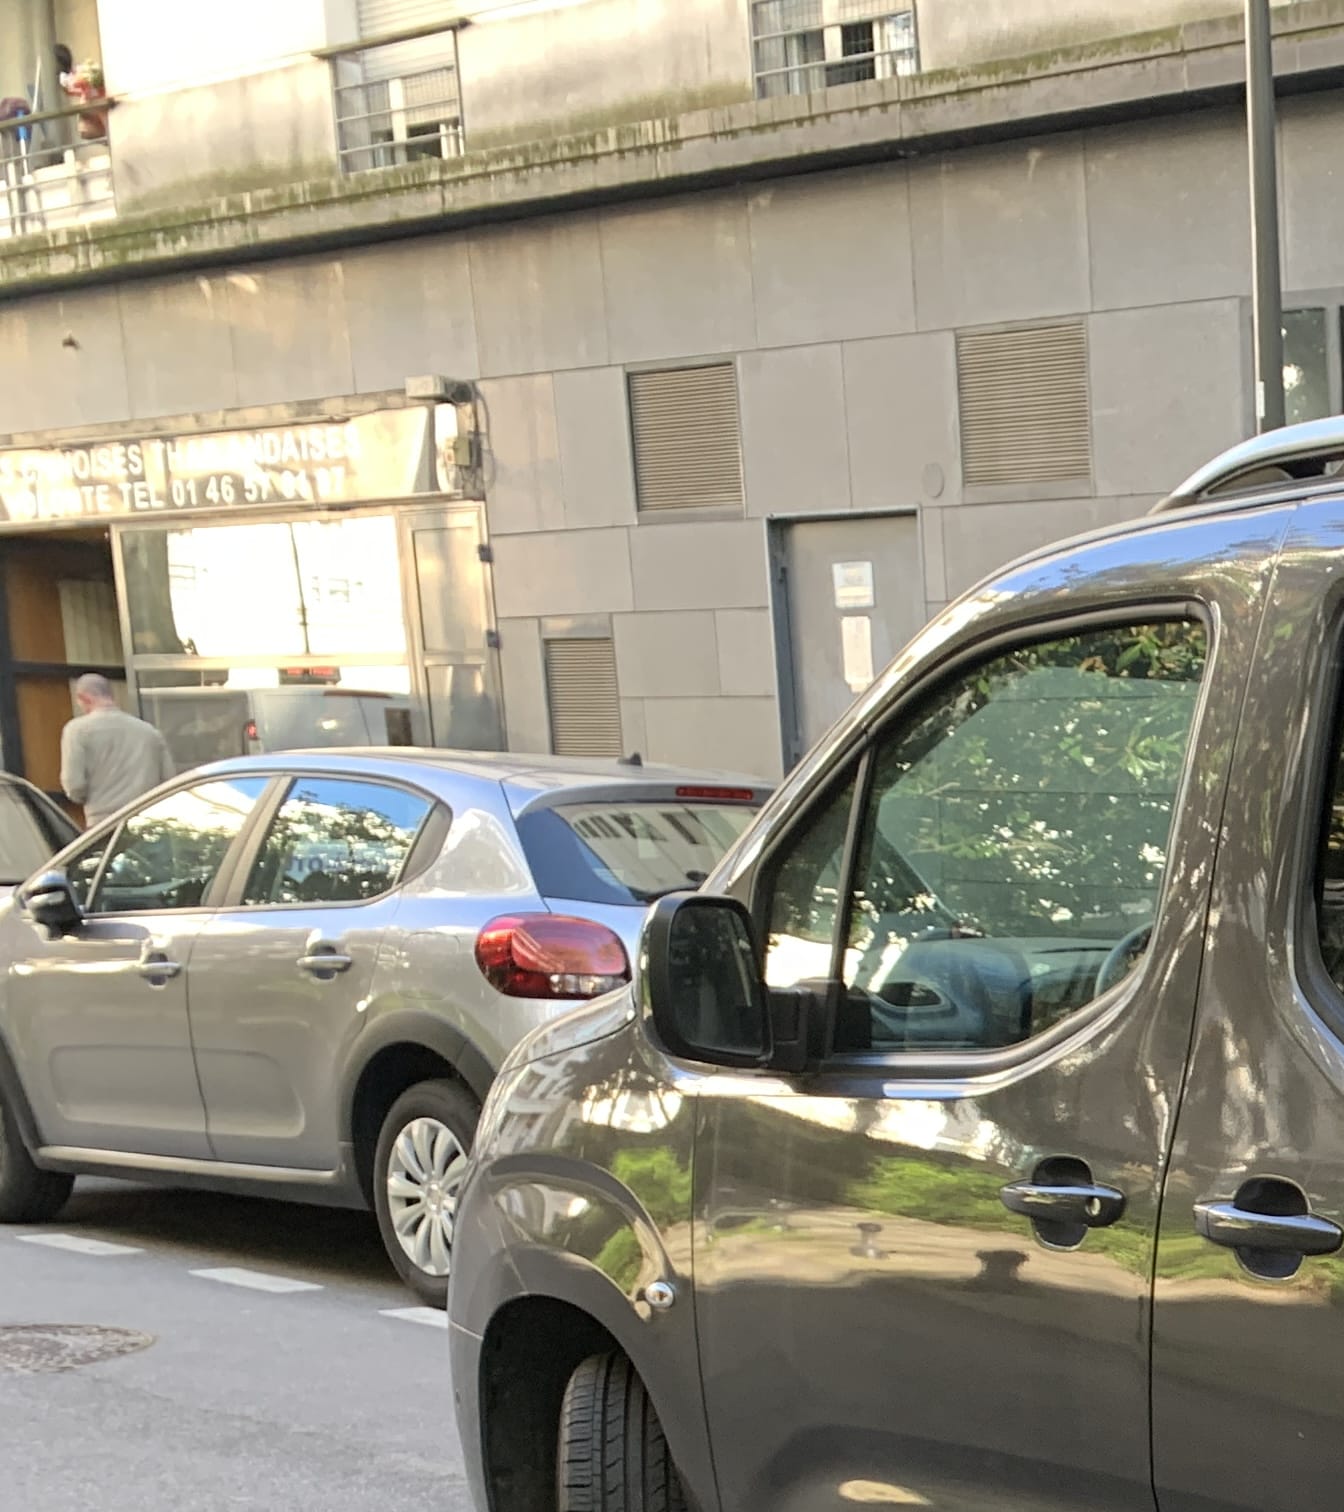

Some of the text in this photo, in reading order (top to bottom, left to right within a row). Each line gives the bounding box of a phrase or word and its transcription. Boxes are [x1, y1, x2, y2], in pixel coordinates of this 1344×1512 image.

[118, 481, 165, 512] TEL
[171, 477, 198, 507] 01
[205, 475, 235, 504] 46
